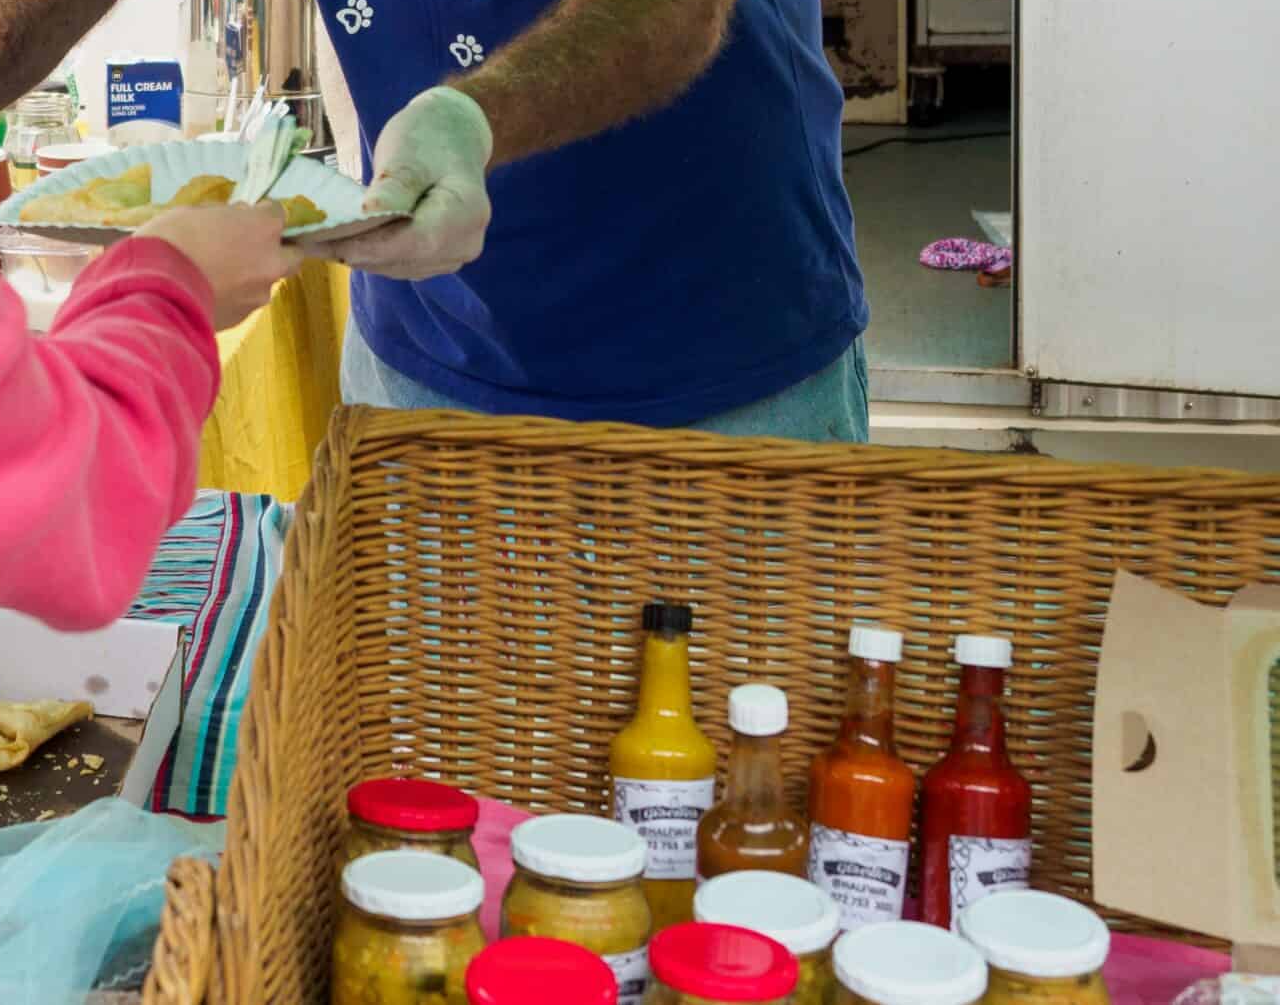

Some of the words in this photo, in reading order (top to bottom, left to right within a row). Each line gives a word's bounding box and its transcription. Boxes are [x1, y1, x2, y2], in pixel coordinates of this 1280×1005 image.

[111, 83, 133, 92] FULL
[135, 81, 172, 92] CREAM
[111, 93, 135, 103] MILK
